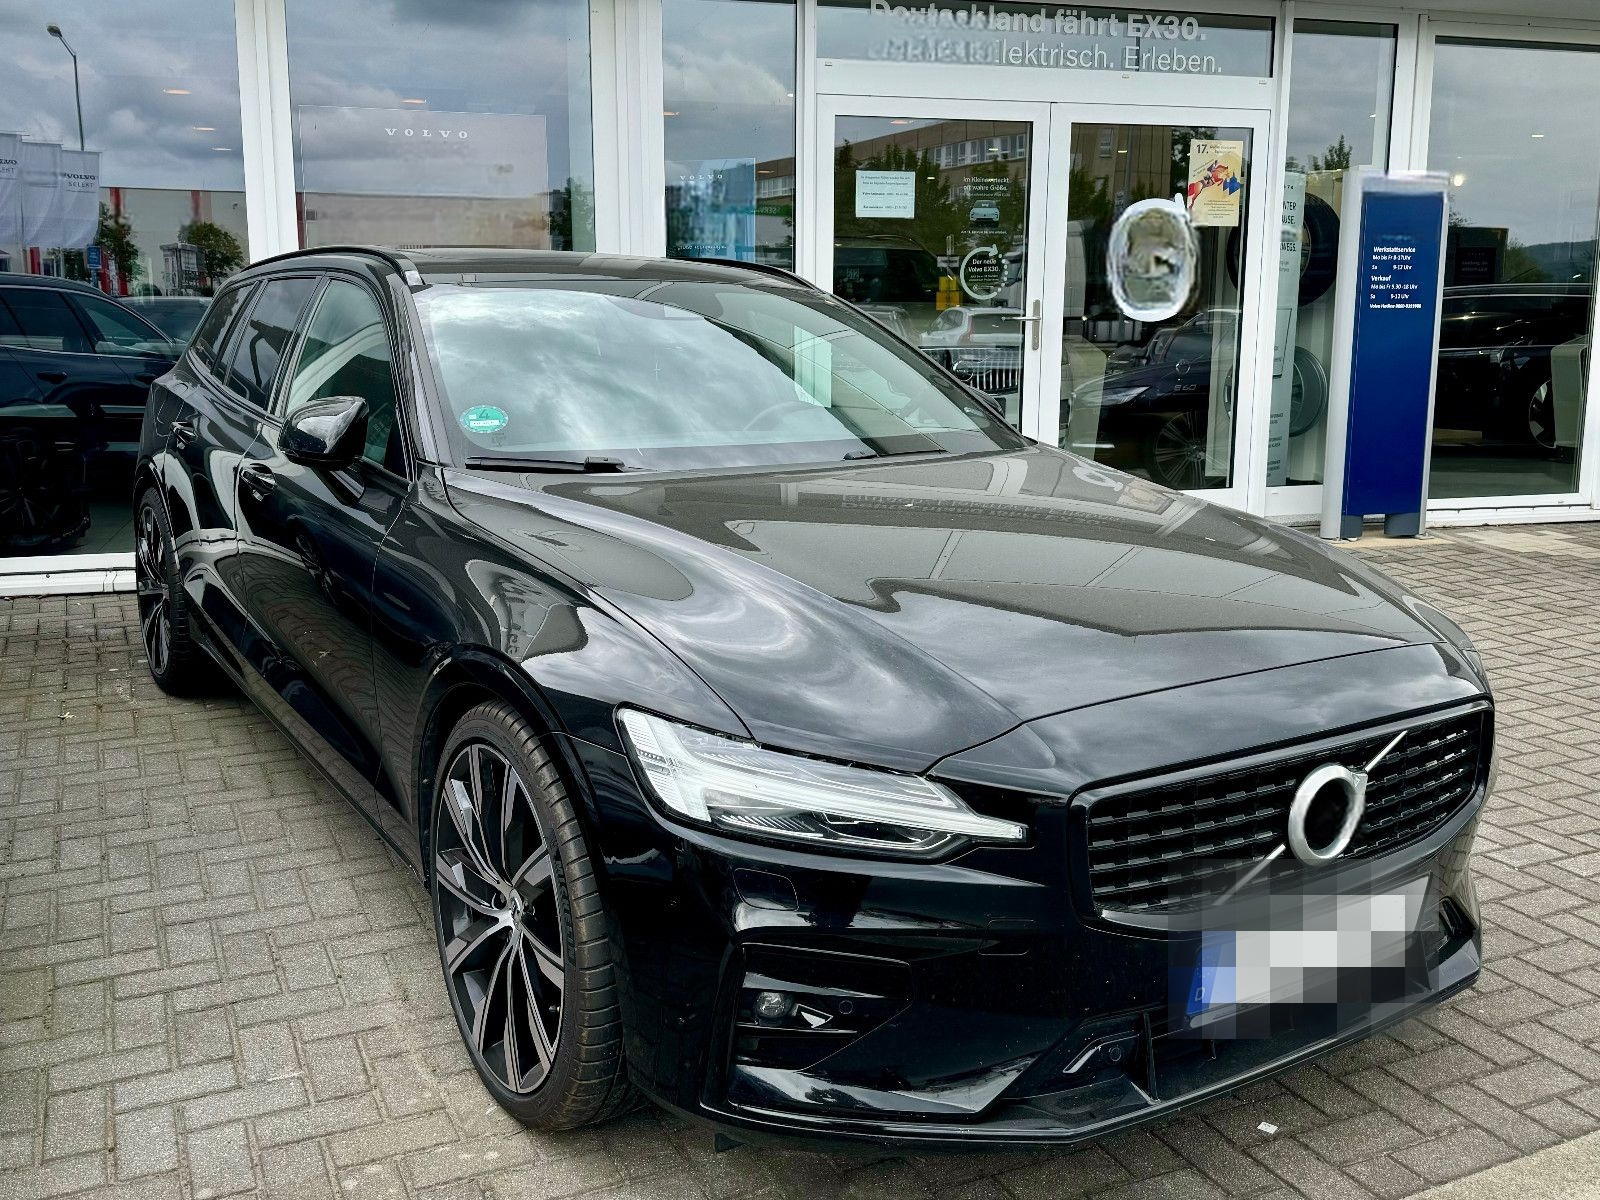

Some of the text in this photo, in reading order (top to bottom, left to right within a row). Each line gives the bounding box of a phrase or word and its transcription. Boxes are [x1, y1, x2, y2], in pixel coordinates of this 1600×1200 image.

[1055, 9, 1119, 37] fährt
[1127, 13, 1207, 41] EX30.
[1124, 45, 1222, 73] Erleben.
[384, 127, 468, 139] VOLVO
[1196, 143, 1209, 154] 17.
[66, 173, 97, 181] VOLVO
[680, 173, 723, 181] VOLVO
[1194, 986, 1206, 1002] D
